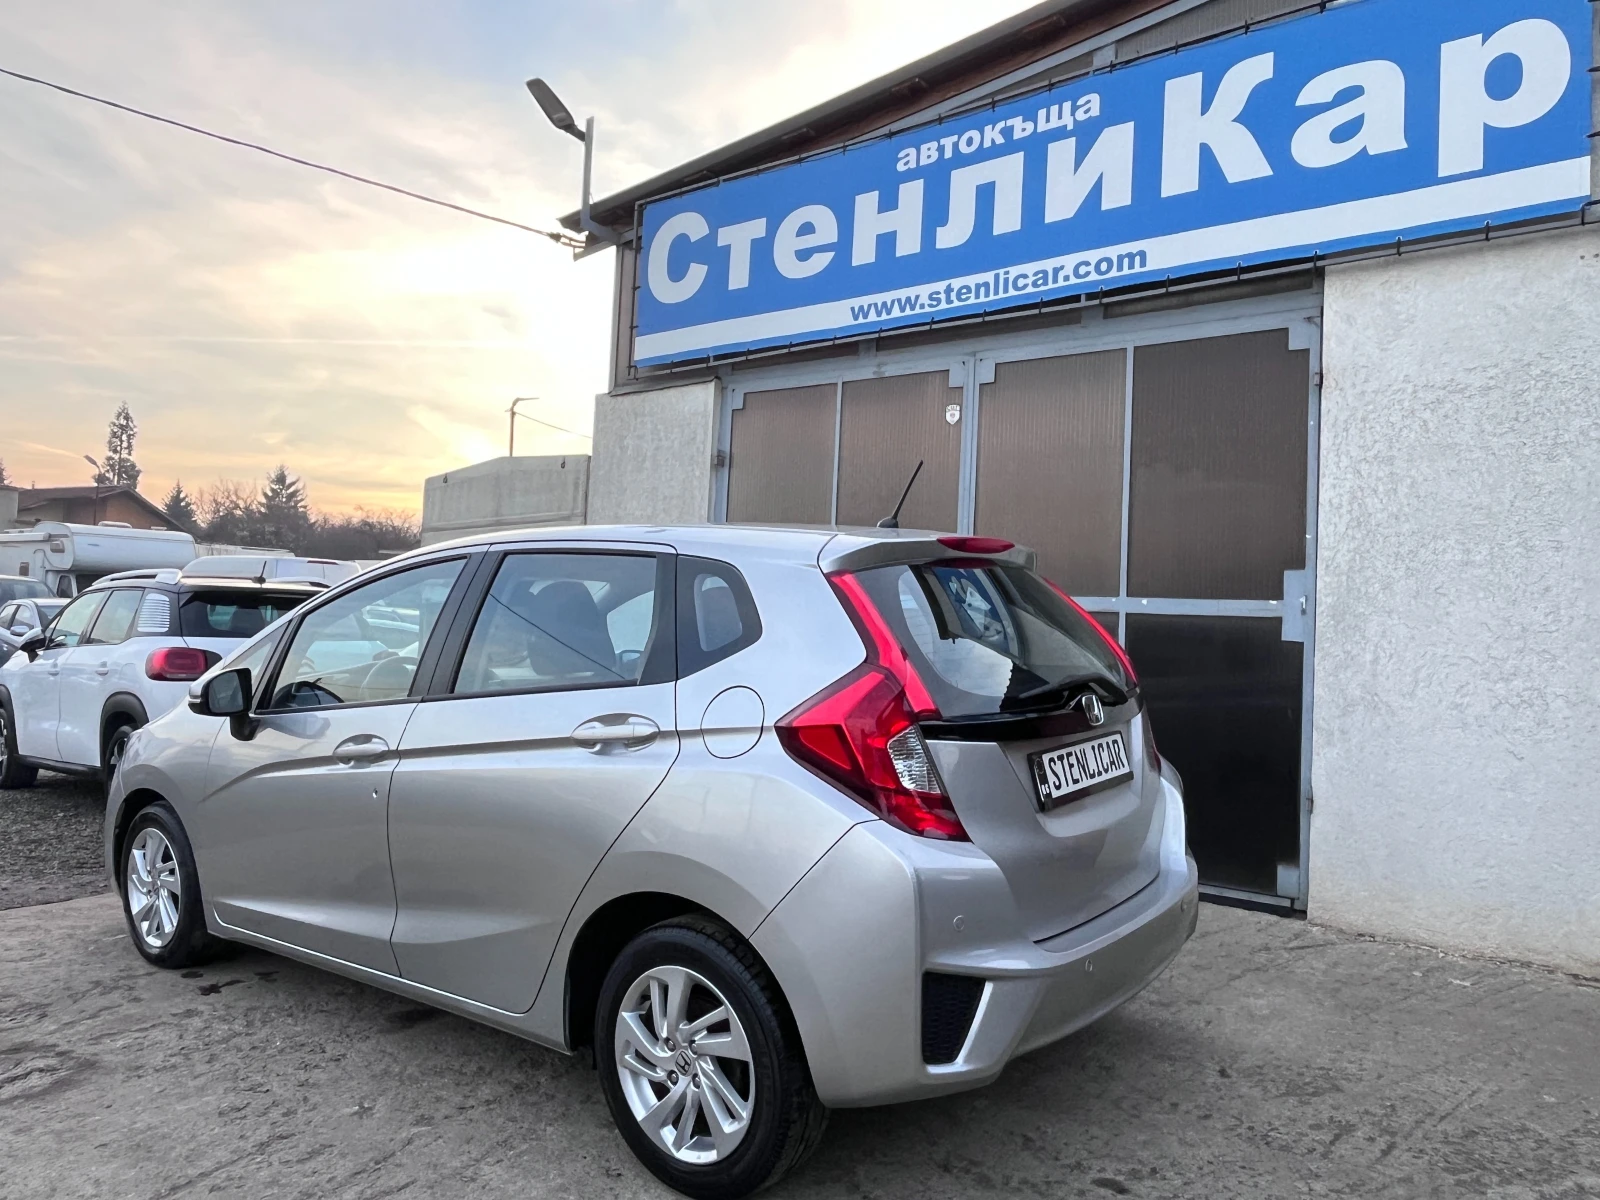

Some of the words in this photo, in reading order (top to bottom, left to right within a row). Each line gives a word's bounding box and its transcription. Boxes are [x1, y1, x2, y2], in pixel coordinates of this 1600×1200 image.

[896, 91, 1102, 172] автокъща
[850, 247, 1148, 322] www.stenlicar.com
[1048, 739, 1125, 791] STENLICAR
